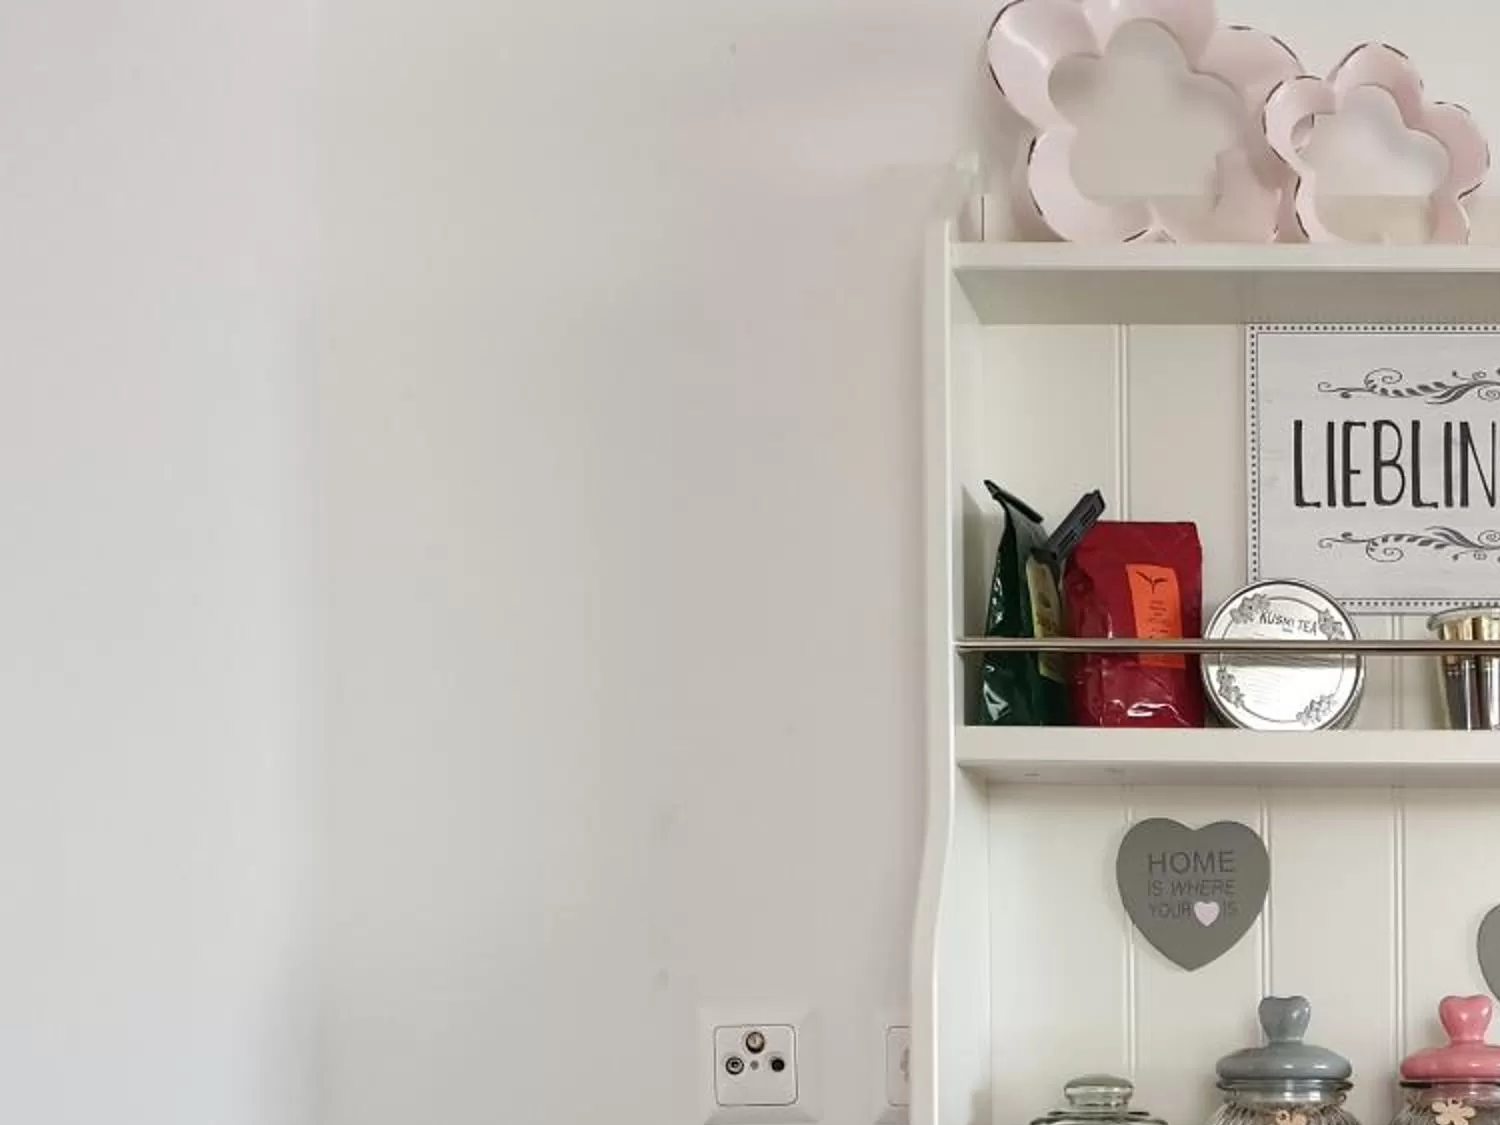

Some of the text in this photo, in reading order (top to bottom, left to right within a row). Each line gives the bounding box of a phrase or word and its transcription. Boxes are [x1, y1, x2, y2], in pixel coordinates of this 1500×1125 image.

[1298, 619, 1318, 636] TEA
[1148, 850, 1237, 875] HOME
[1147, 879, 1237, 898] IS WHERE
